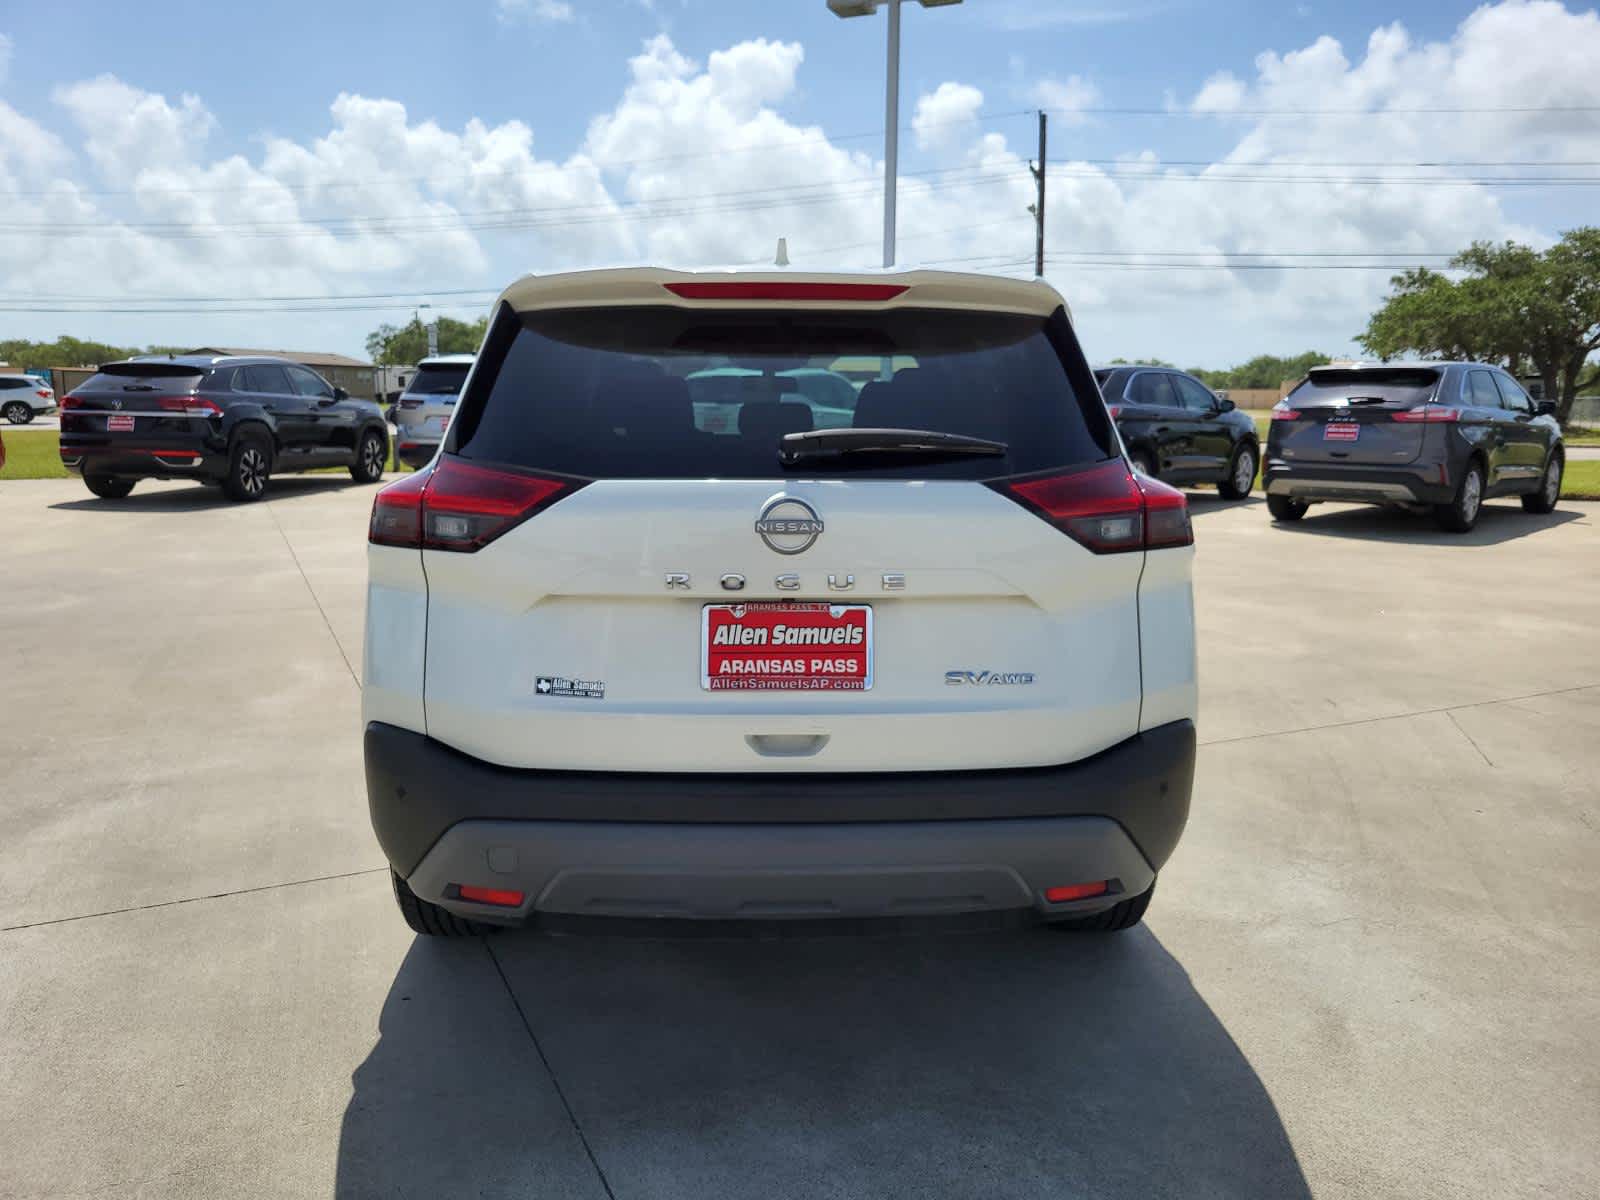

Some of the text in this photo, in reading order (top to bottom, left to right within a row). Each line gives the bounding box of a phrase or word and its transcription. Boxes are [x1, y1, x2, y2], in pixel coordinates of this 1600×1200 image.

[756, 521, 822, 532] NISSAN
[664, 573, 906, 591] ROGUE
[713, 624, 864, 646] Allen Samuels
[719, 659, 858, 674] ARANSAS PASS
[711, 678, 865, 690] AllenSamuelsAP.com
[945, 671, 989, 686] SV
